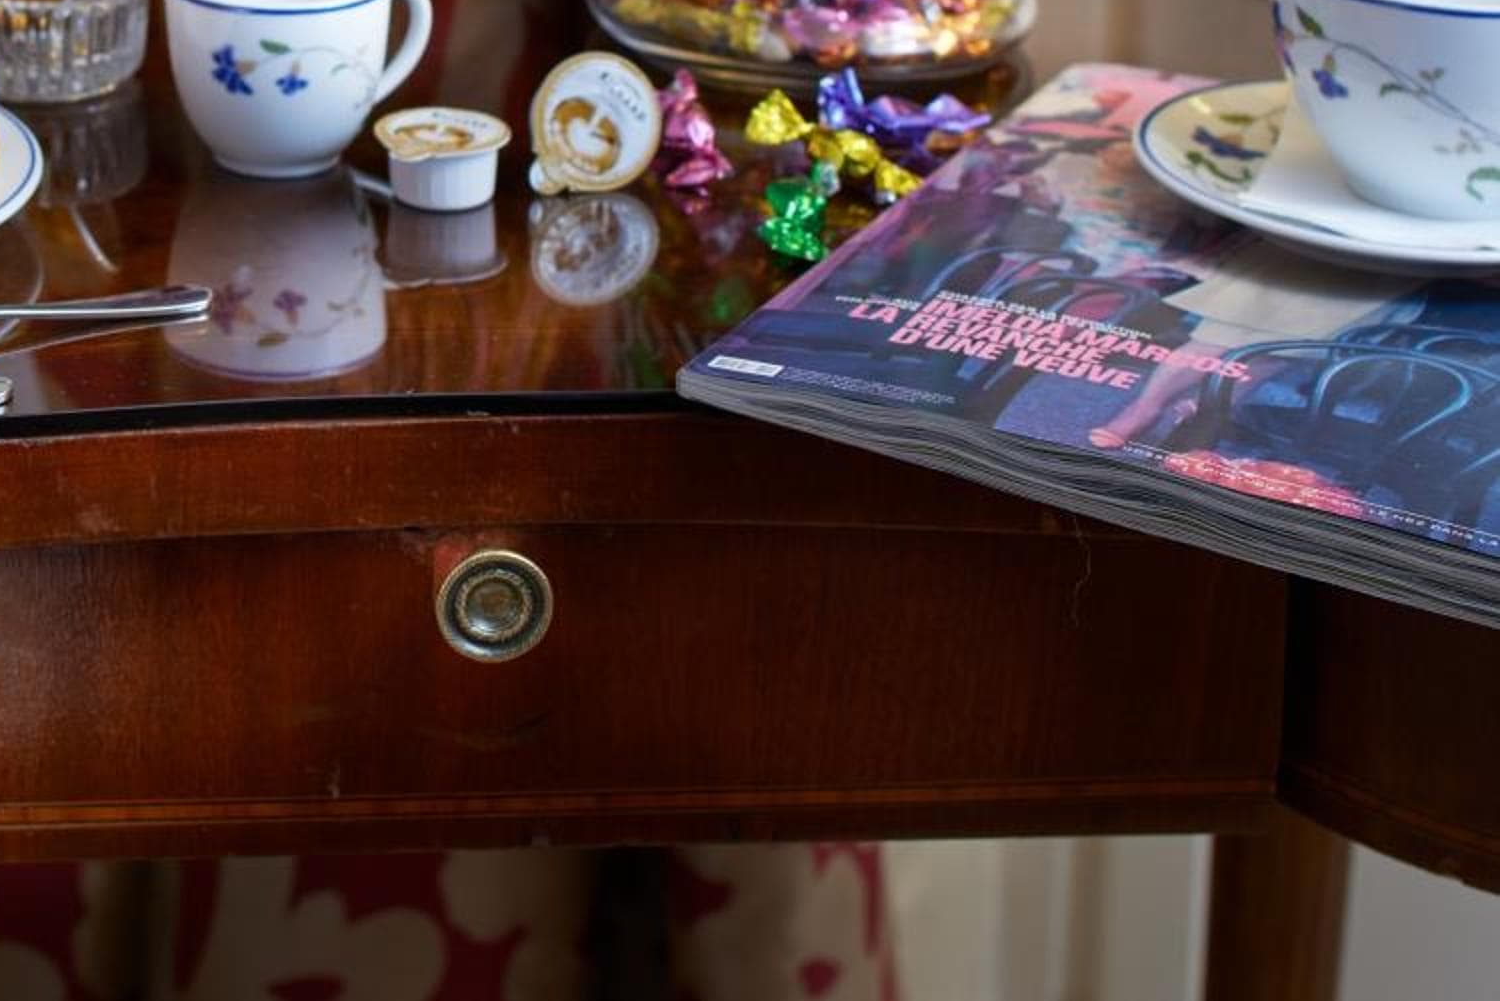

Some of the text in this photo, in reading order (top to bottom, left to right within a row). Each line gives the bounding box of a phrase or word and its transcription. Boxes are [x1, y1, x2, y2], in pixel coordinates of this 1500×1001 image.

[848, 302, 901, 324] LA
[904, 312, 1106, 366] REVANCHE
[919, 299, 1066, 341] IMELDA
[887, 327, 1142, 390] D'UNE VEUVE
